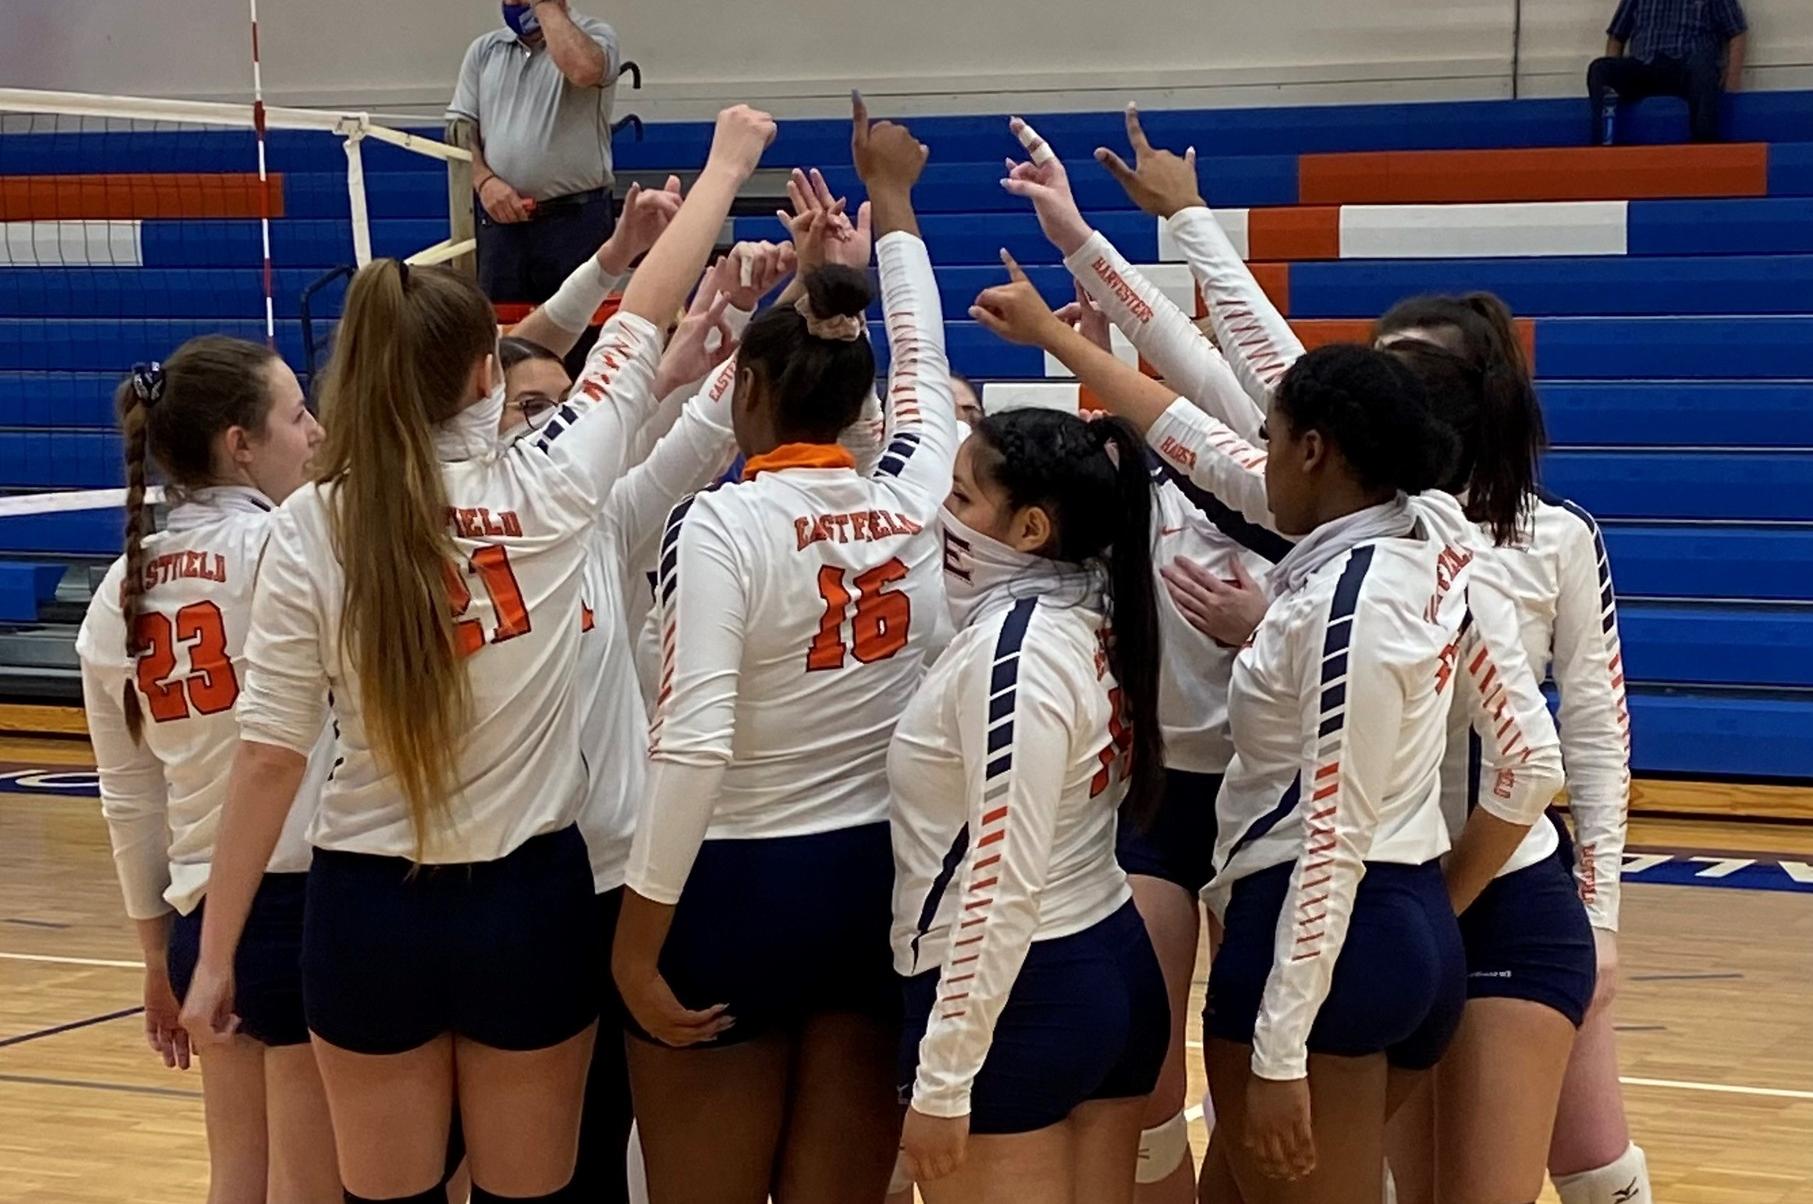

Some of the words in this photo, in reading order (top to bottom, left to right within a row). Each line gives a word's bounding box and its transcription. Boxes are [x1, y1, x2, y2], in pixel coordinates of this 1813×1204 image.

[794, 509, 924, 551] EASTFELD
[943, 527, 973, 582] E
[805, 555, 911, 673] 16
[133, 599, 240, 723] 23
